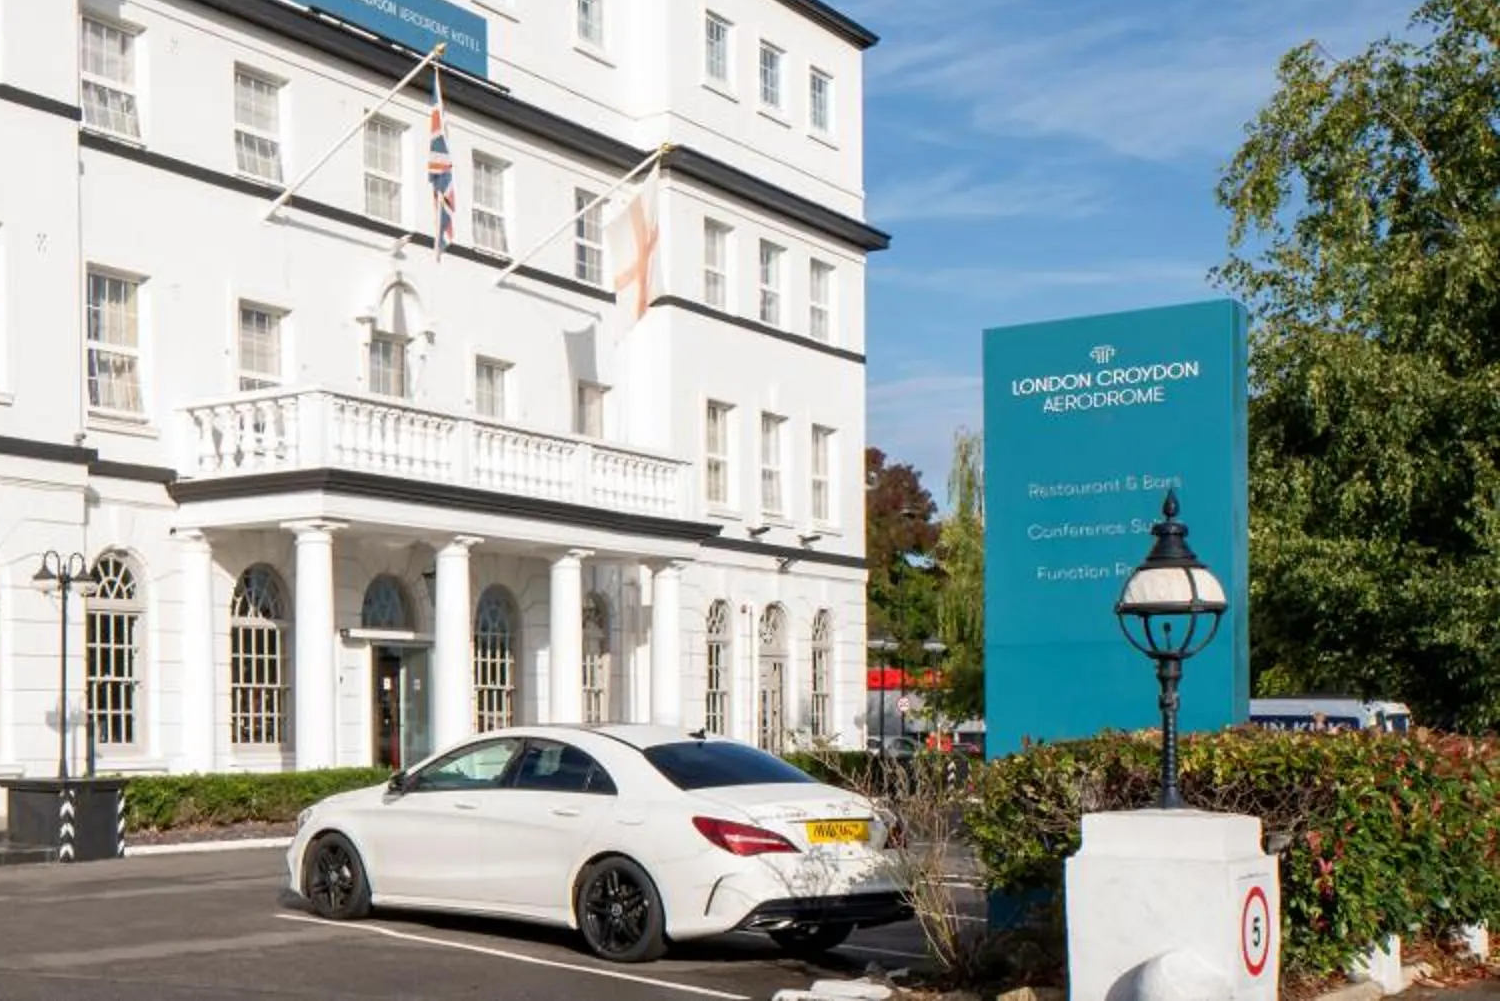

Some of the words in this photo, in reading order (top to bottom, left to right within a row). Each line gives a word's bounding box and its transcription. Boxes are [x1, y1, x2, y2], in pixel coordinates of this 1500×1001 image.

[1011, 372, 1092, 396] LONDON
[1096, 360, 1200, 386] CROYDON
[1043, 385, 1166, 413] AERODROME
[1027, 478, 1121, 499] Restaurant
[1026, 521, 1126, 540] Conference
[1036, 564, 1110, 581] Function
[1252, 916, 1261, 948] 5
